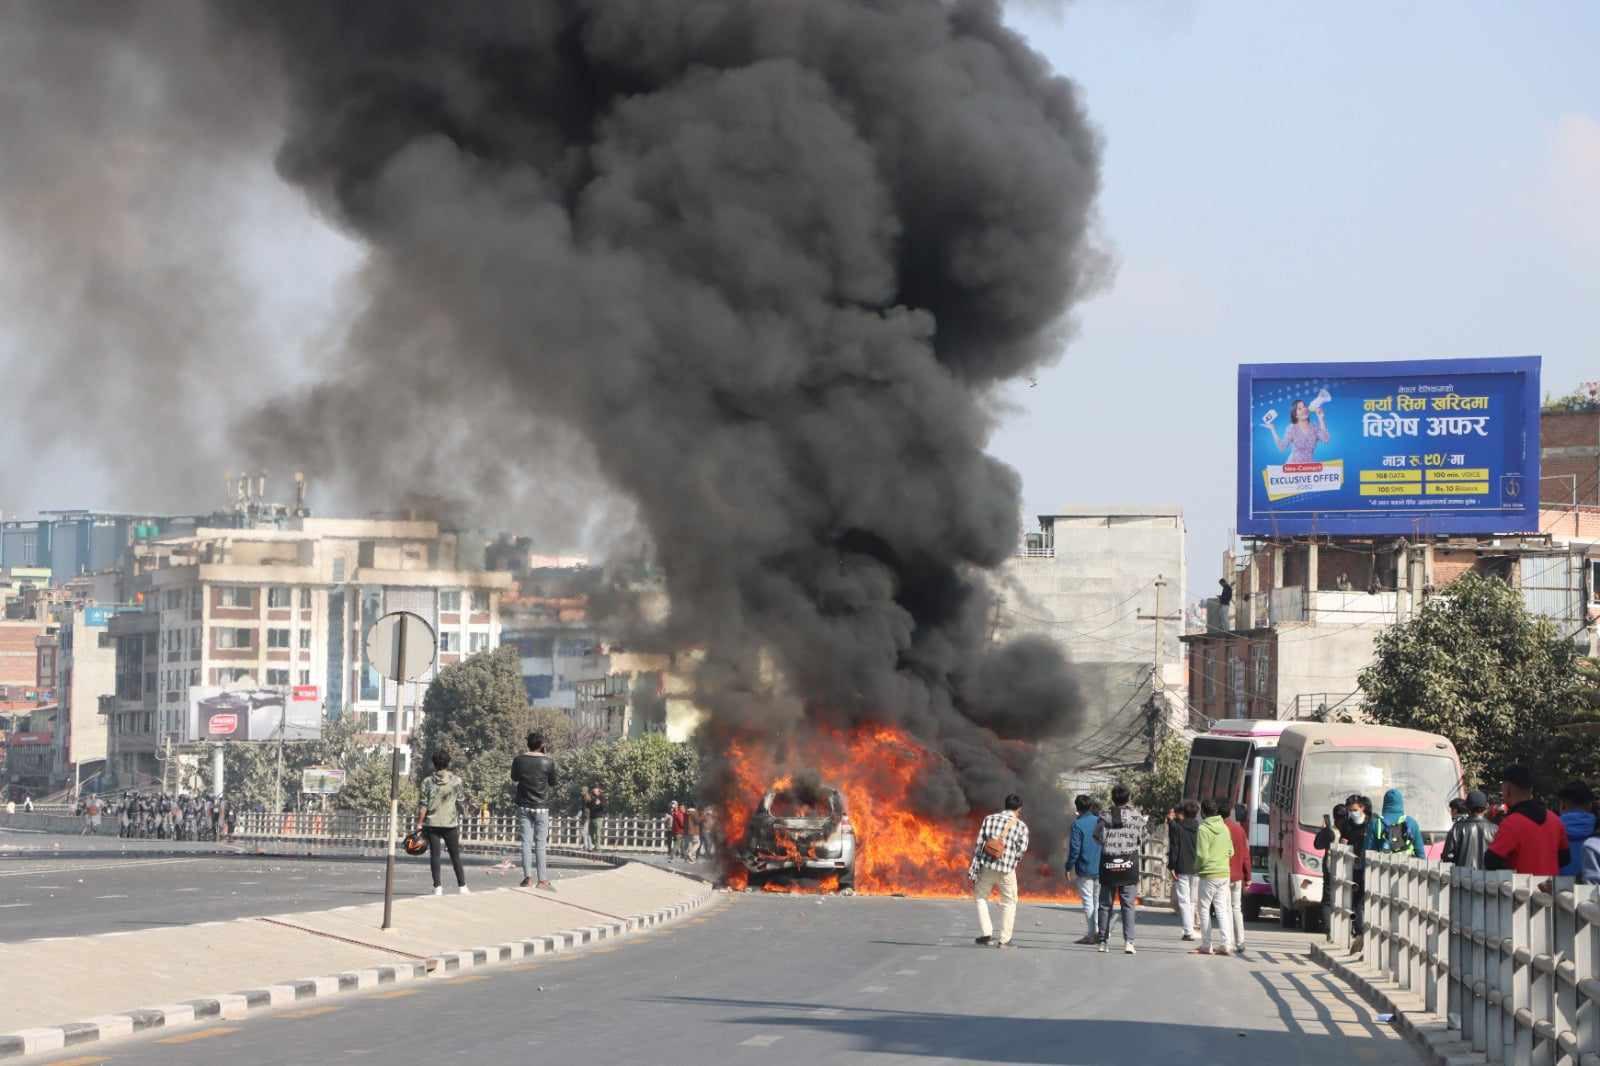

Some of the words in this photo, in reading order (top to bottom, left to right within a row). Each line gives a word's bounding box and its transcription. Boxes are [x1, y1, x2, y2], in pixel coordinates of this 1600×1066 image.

[1397, 394, 1426, 412] सिम
[1362, 412, 1420, 438] विशेष
[1426, 416, 1490, 436] अफर
[1382, 455, 1406, 467] मात्र
[1270, 475, 1312, 486] EXCLUSIVE
[1313, 473, 1340, 483] OFFER
